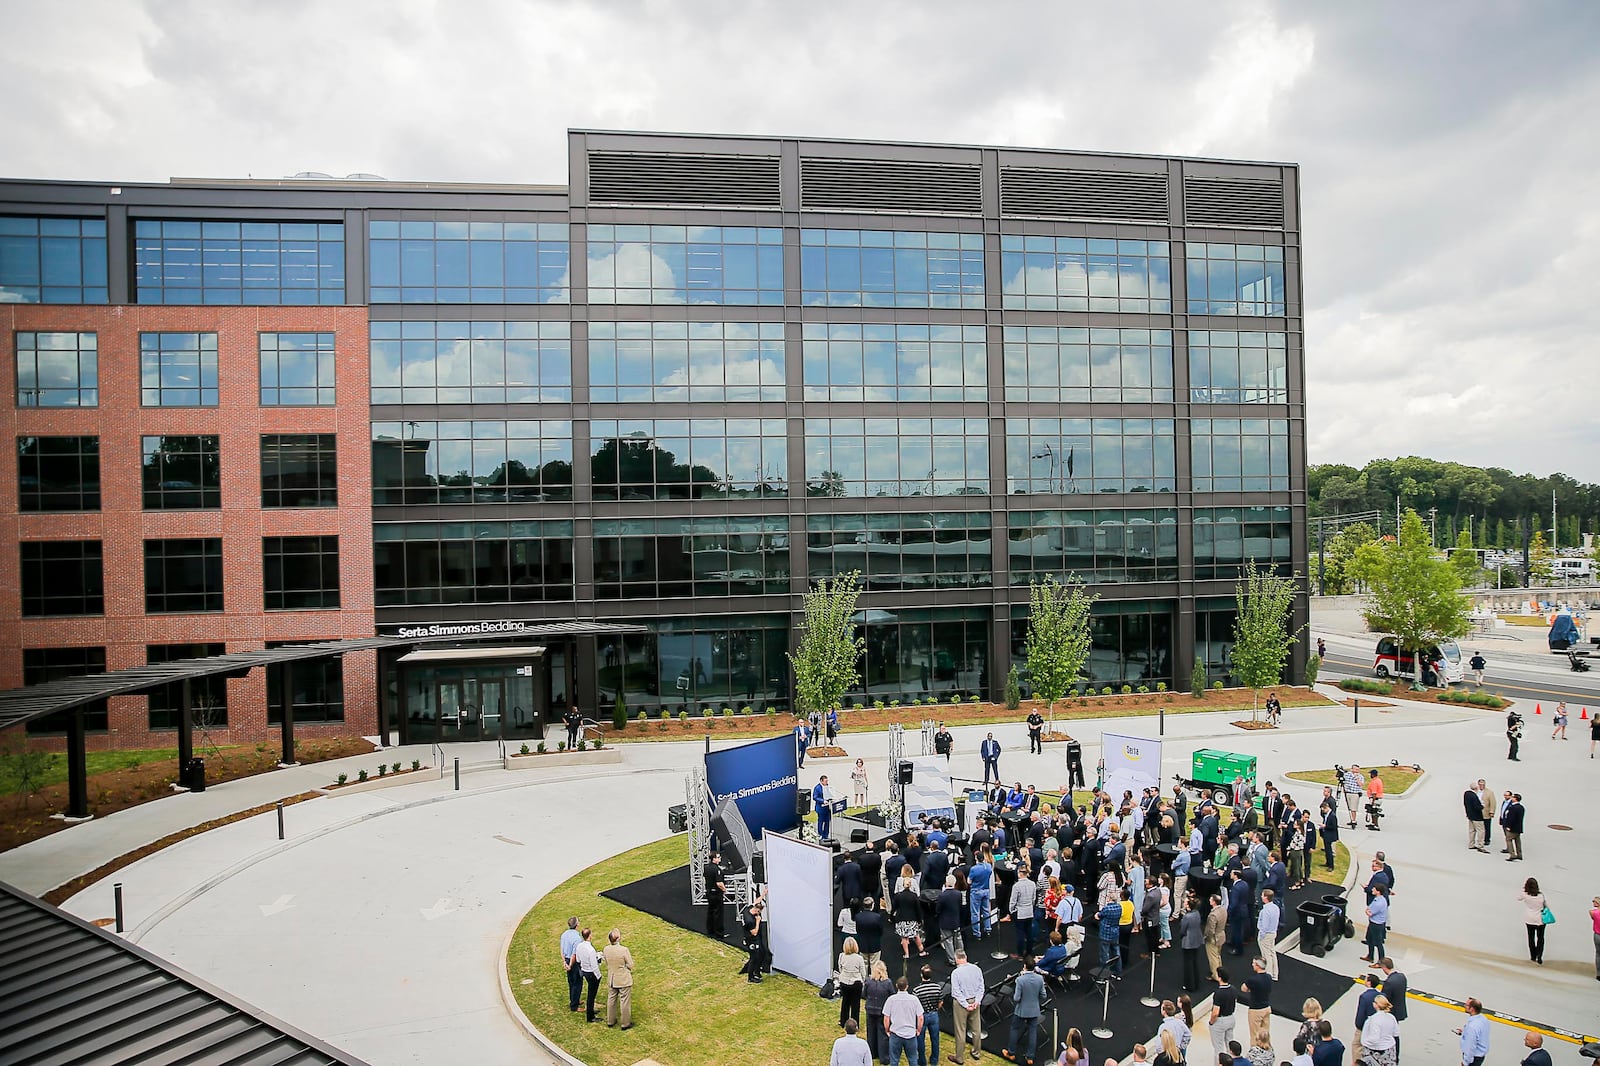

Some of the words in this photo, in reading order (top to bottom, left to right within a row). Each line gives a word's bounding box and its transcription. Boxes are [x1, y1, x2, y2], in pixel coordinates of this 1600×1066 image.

[398, 626, 428, 638] Serta
[428, 624, 480, 635] Simmons
[480, 620, 525, 632] Bedding
[1125, 744, 1140, 756] Serta
[738, 783, 772, 798] Simmons
[771, 775, 796, 789] Bedding
